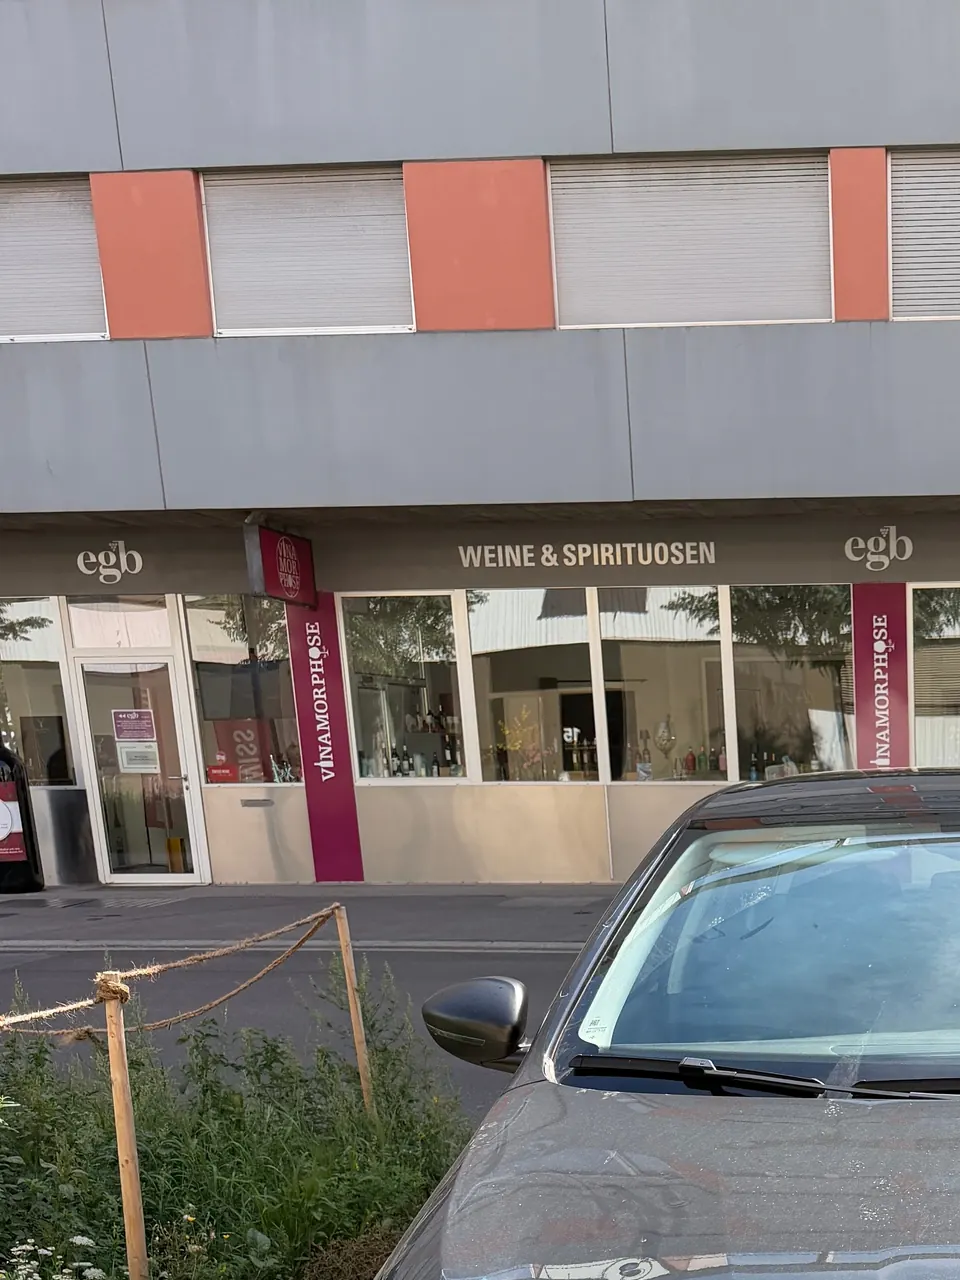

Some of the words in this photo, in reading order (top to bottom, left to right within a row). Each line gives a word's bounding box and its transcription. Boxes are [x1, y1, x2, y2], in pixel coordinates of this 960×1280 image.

[77, 540, 143, 585] egb
[458, 545, 536, 568] WEINE
[541, 543, 559, 566] &
[563, 541, 716, 566] SPIRITUOSEN
[844, 525, 914, 572] egb
[869, 614, 895, 769] INAMORPHOSE
